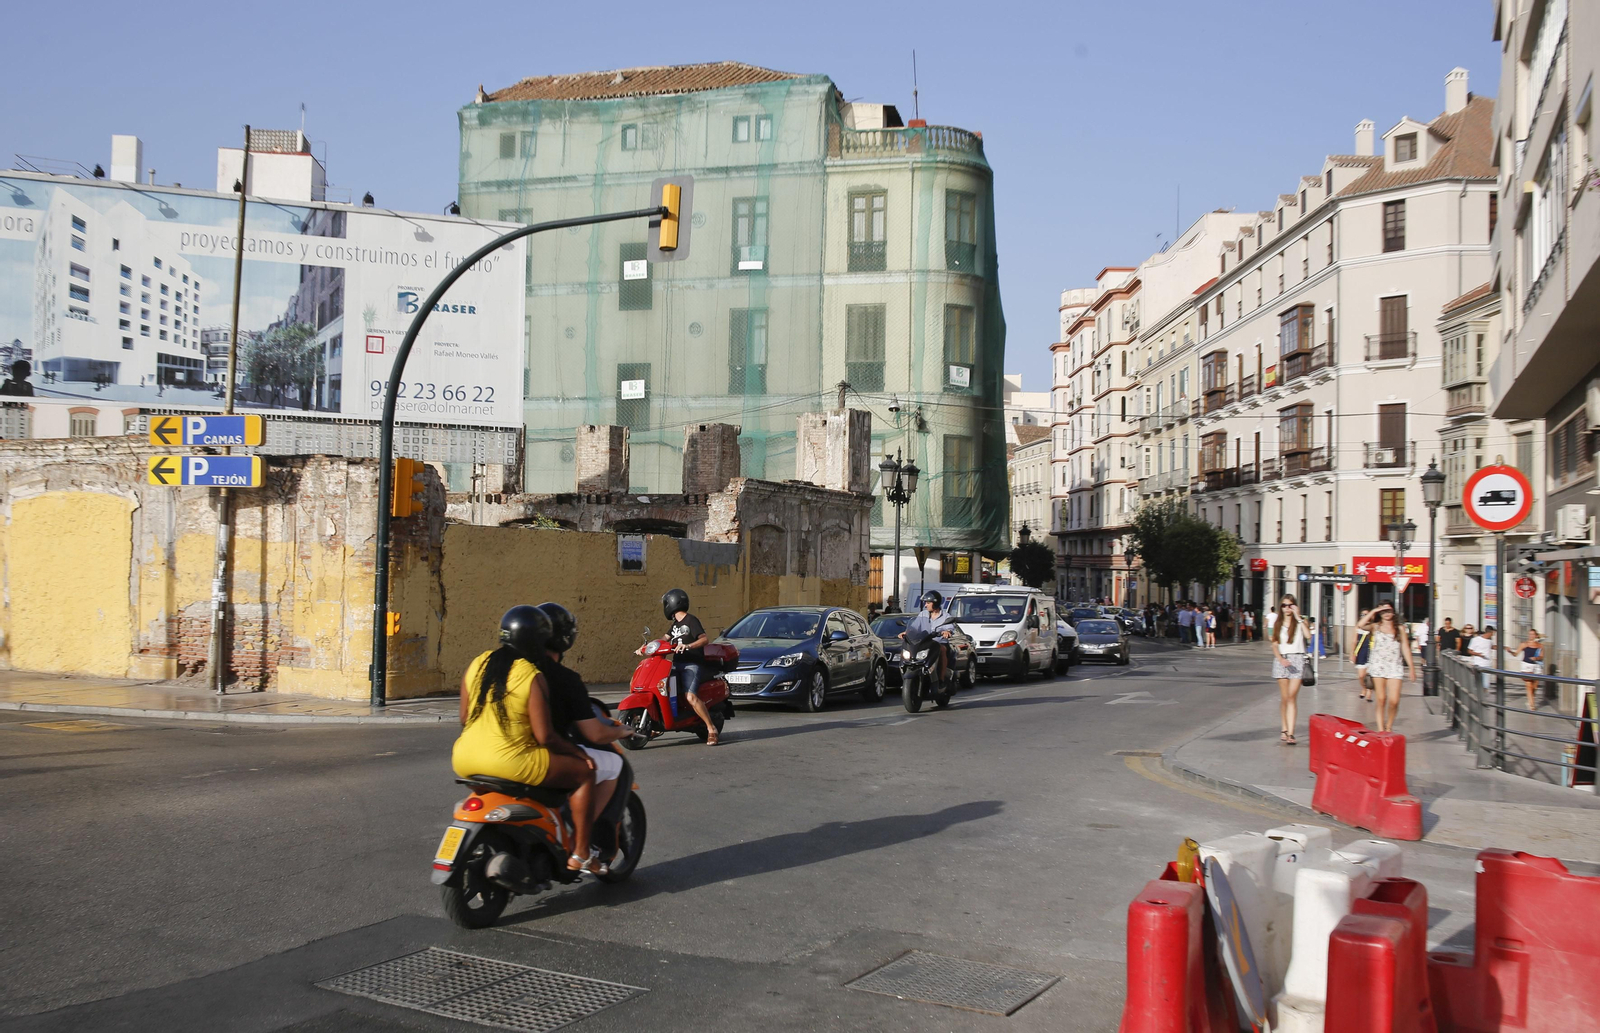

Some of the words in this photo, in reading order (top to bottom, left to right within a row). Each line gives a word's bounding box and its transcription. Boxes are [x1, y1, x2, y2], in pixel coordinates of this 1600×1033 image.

[0, 215, 34, 233] ora
[300, 243, 309, 261] y
[315, 243, 418, 267] construimos
[424, 250, 437, 268] el
[422, 302, 477, 315] RASER
[434, 349, 455, 358] Rafael
[456, 351, 479, 359] Moneo
[413, 382, 436, 400] 23
[442, 384, 467, 402] 66
[472, 386, 495, 403] 22
[186, 416, 207, 445] P
[203, 435, 242, 445] CAMAS
[188, 457, 209, 485] P
[211, 474, 246, 485] TEJÓN
